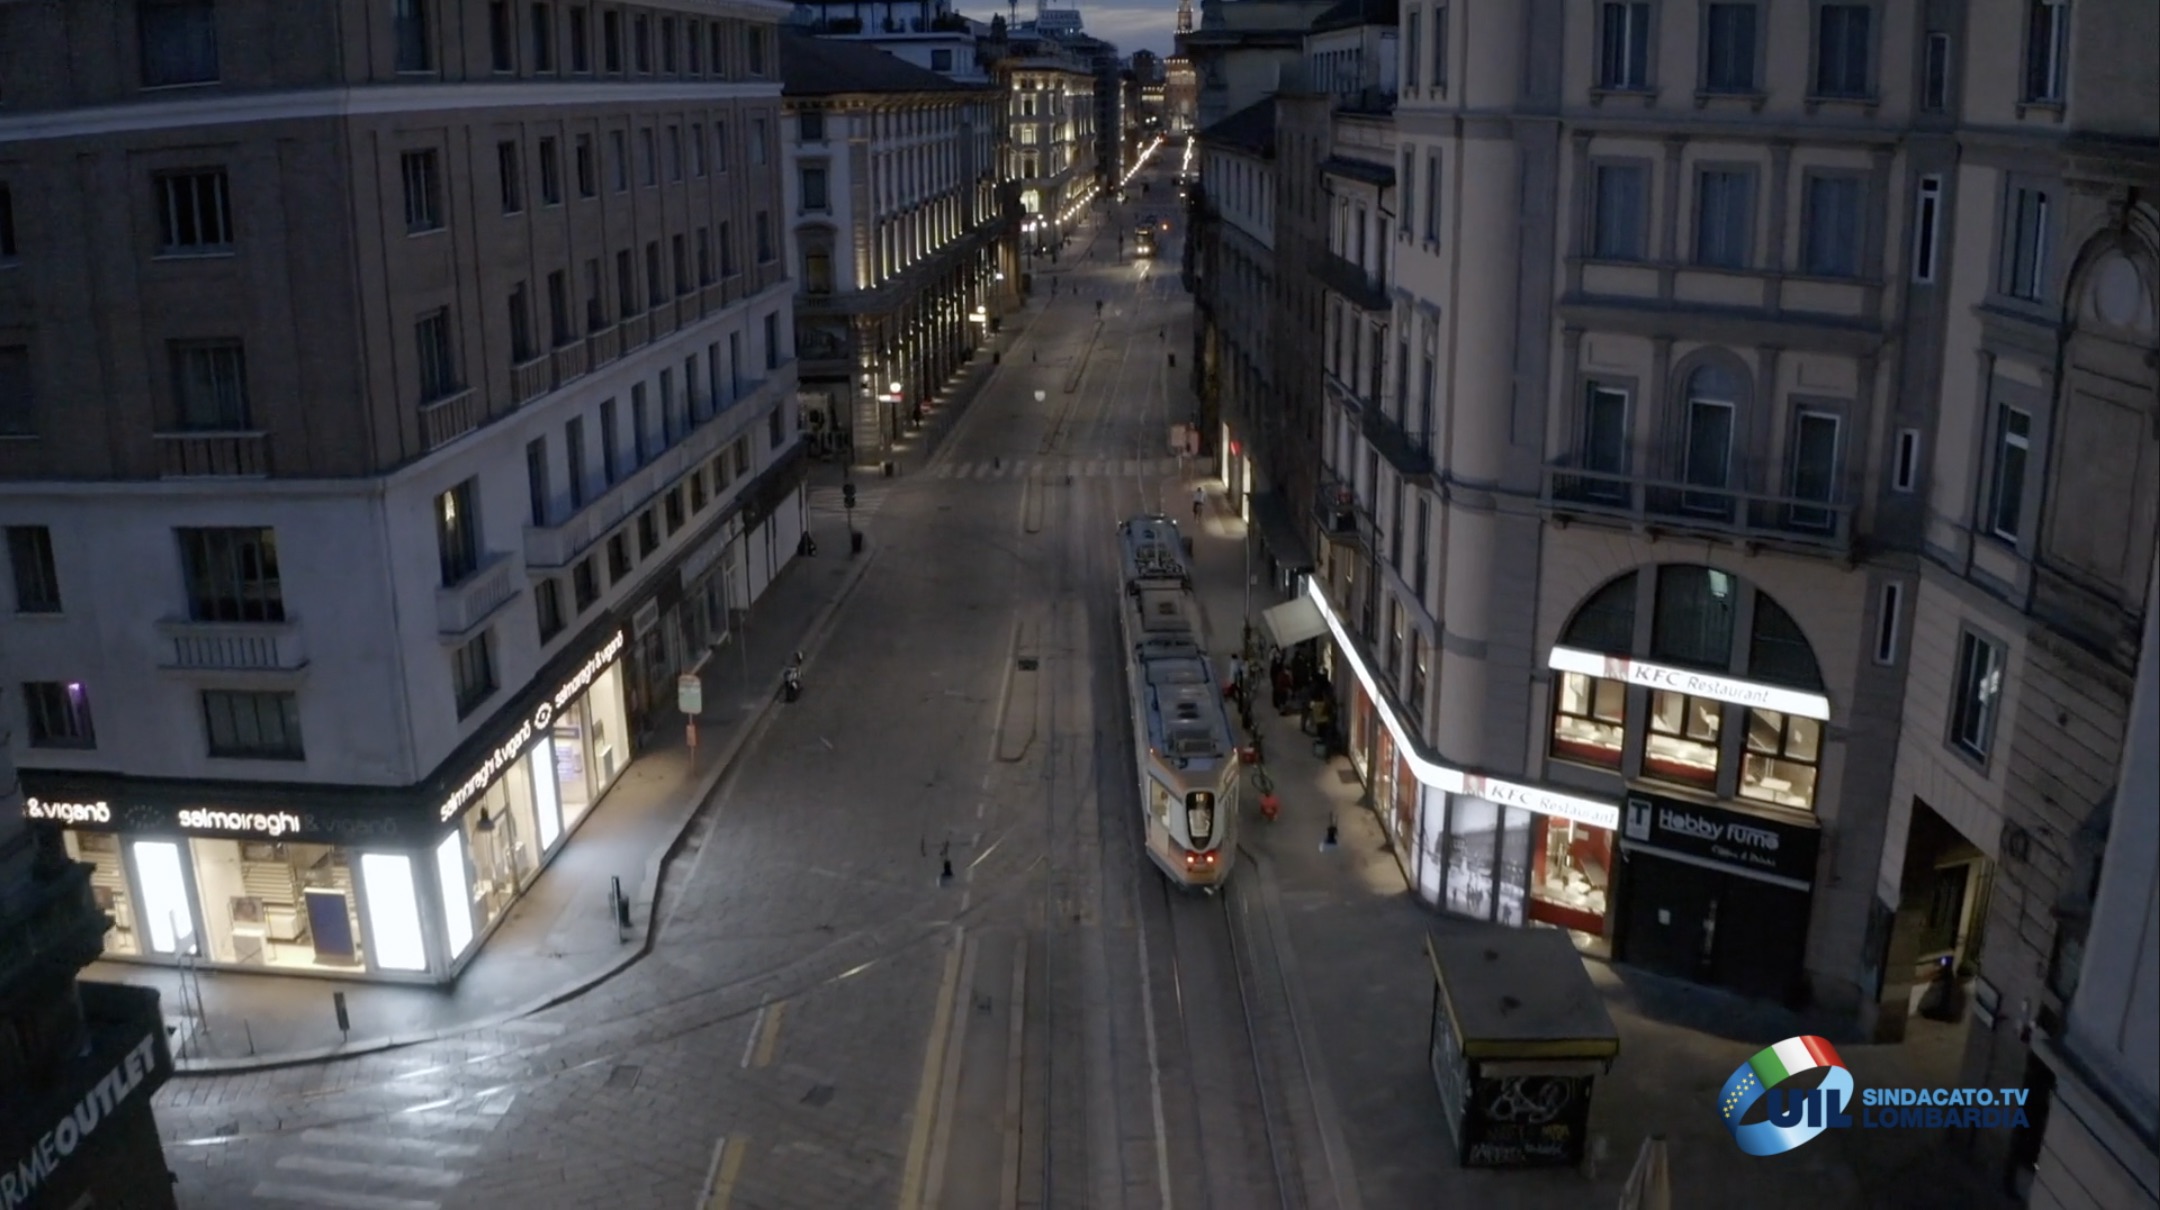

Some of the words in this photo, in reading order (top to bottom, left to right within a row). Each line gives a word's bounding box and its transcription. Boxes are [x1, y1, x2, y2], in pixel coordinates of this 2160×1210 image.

[1634, 664, 1681, 687] KFC
[1687, 676, 1769, 703] Restaurant
[1491, 784, 1531, 804] KFC
[1539, 796, 1616, 824] Restaurant
[1631, 802, 1648, 826] T
[178, 807, 300, 836] salmoiraghi
[1658, 808, 1724, 841] Hobby
